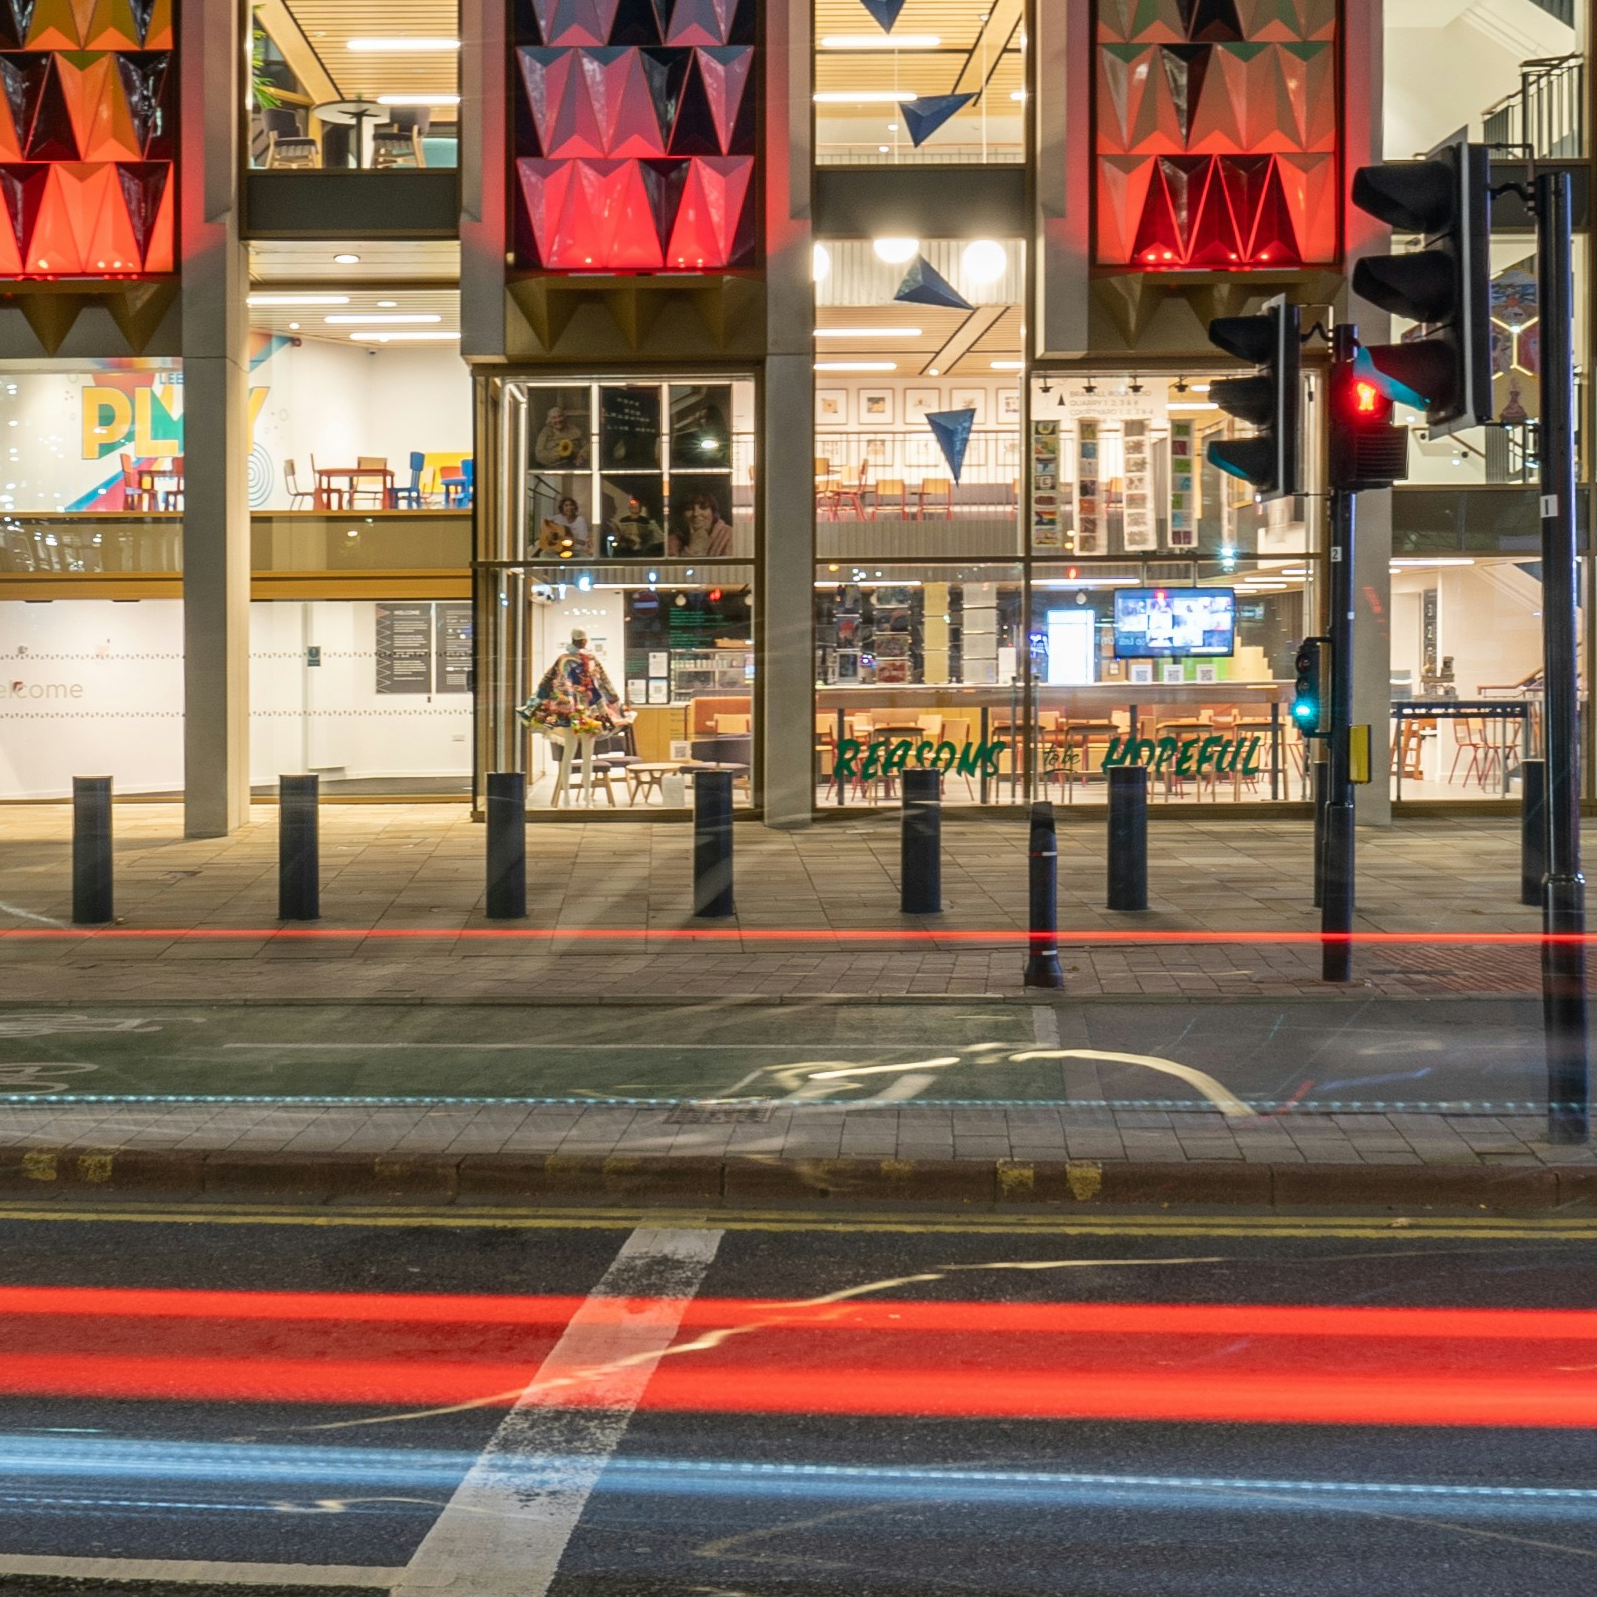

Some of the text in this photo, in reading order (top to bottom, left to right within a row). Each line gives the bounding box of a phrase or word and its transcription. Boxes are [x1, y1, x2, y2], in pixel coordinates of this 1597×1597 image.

[159, 374, 183, 384] LEE
[82, 386, 271, 459] PLY
[834, 738, 1006, 780] REASONS
[1101, 734, 1261, 776] HOPEFUL
